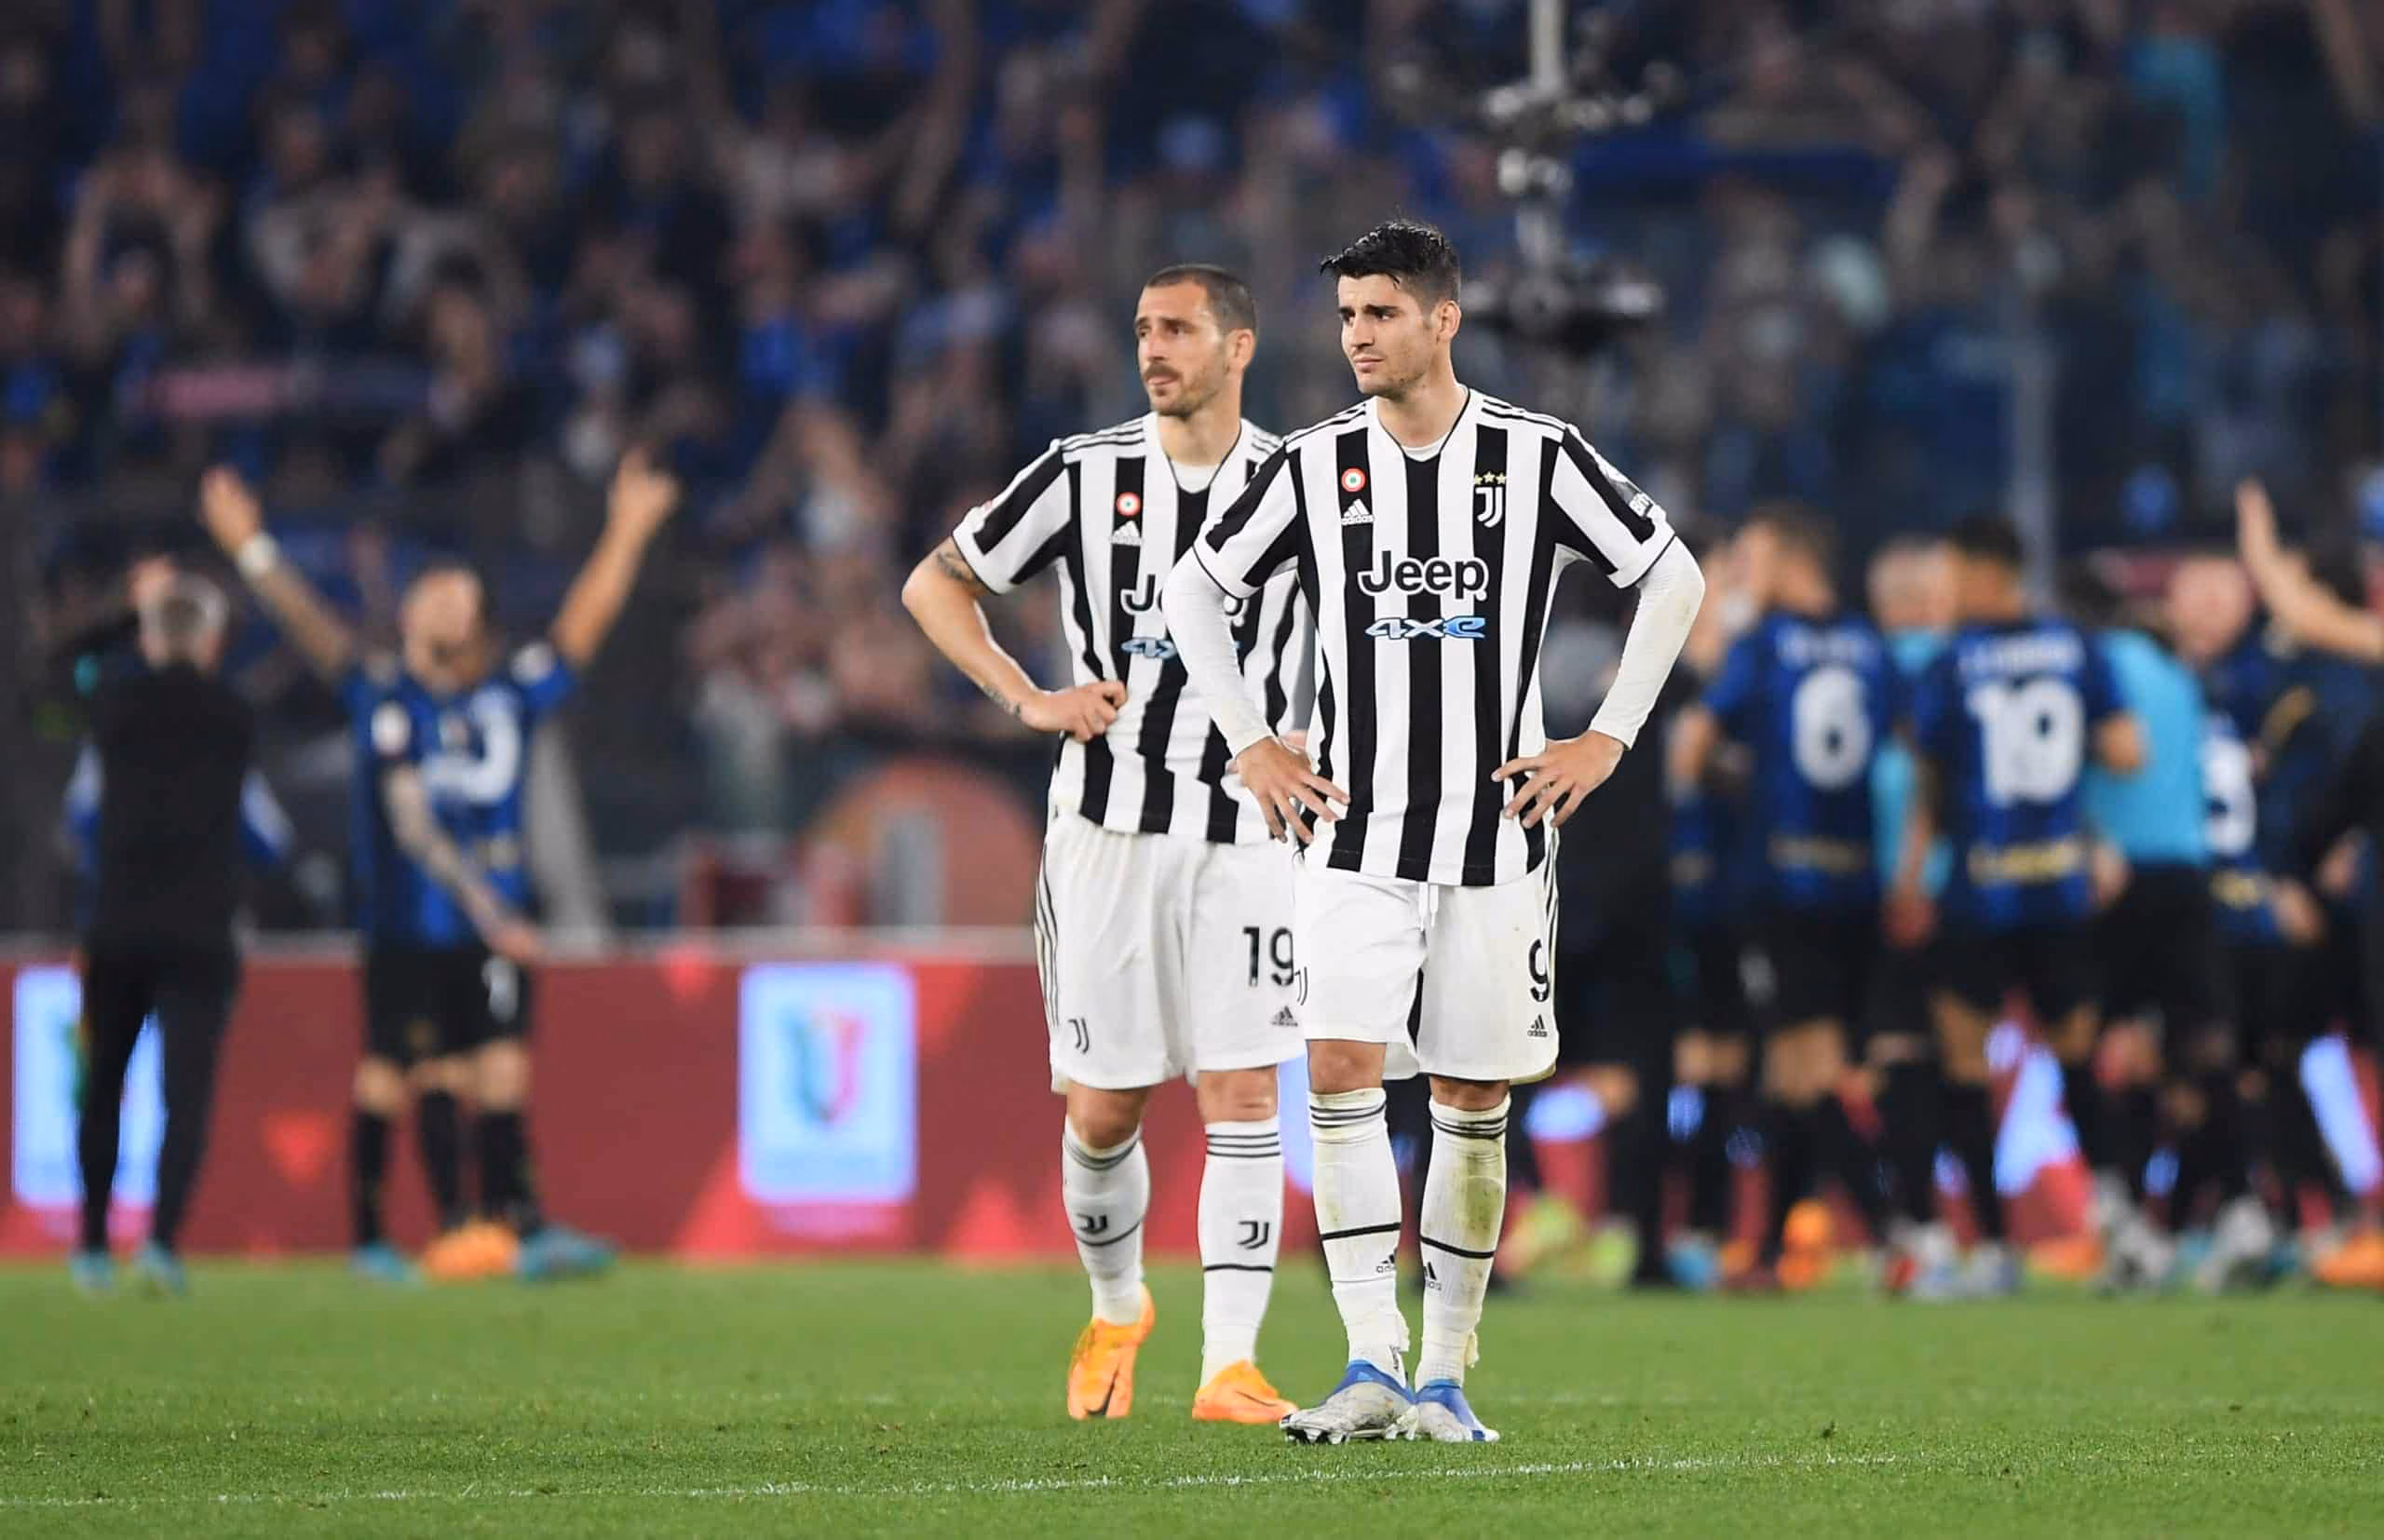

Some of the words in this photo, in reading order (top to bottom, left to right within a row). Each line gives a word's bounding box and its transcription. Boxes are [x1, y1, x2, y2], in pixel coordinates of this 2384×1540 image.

[1358, 547, 1488, 601] Jeep
[1242, 926, 1294, 987] 19
[1528, 938, 1550, 1002] 9
